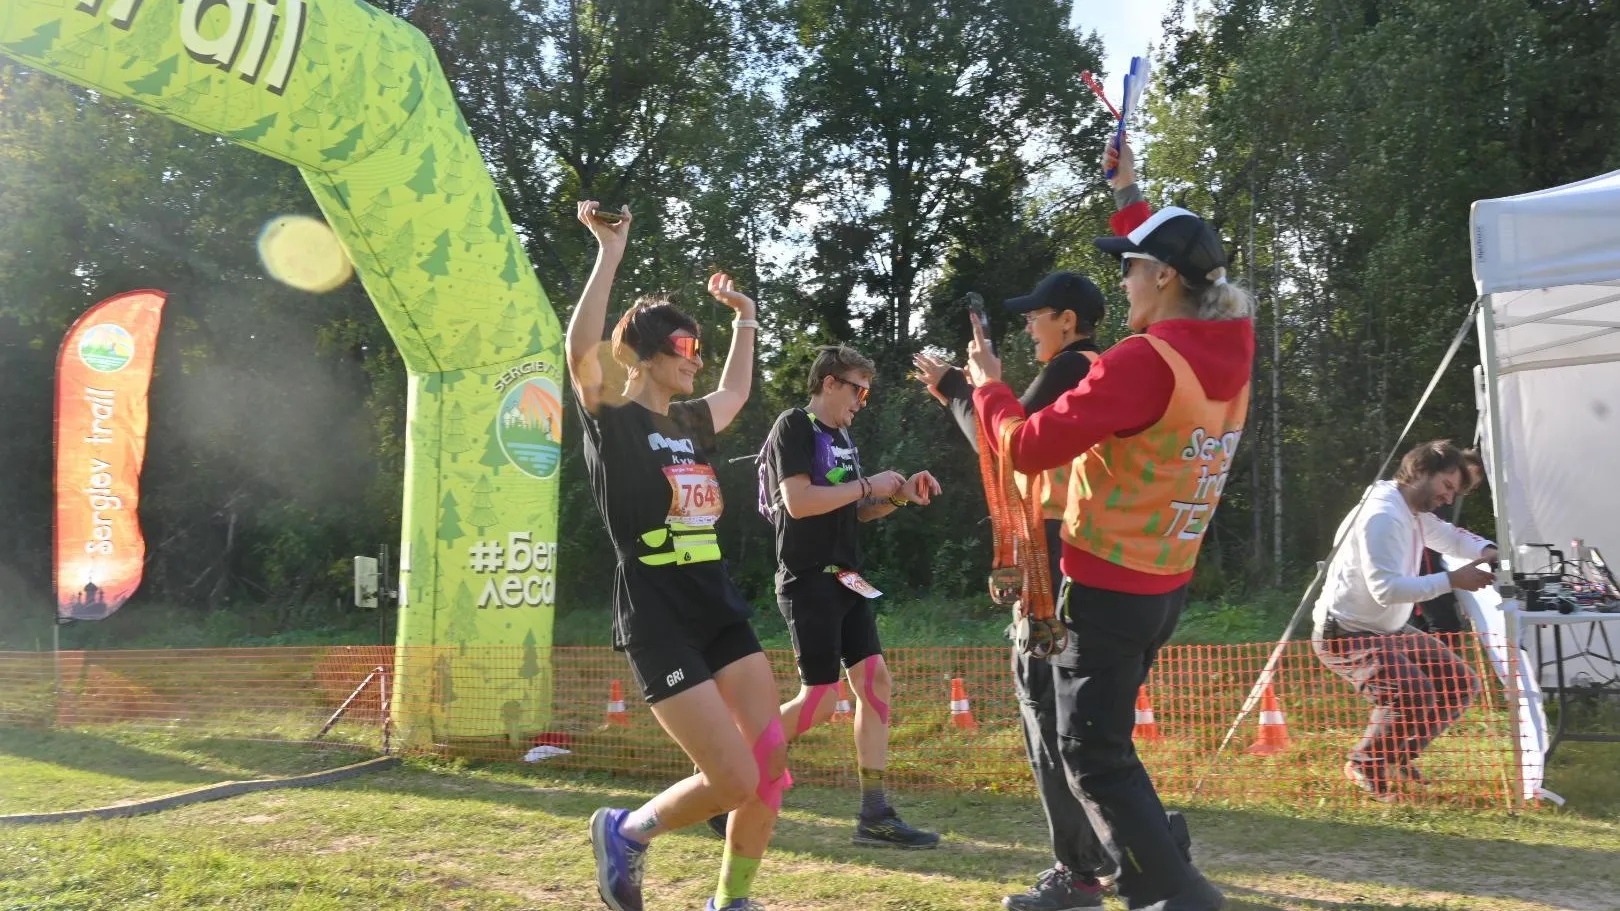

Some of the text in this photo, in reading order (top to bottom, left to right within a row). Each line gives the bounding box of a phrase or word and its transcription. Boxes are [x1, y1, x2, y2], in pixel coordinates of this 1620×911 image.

[83, 386, 123, 556] Sergiev trail
[681, 483, 716, 509] 764
